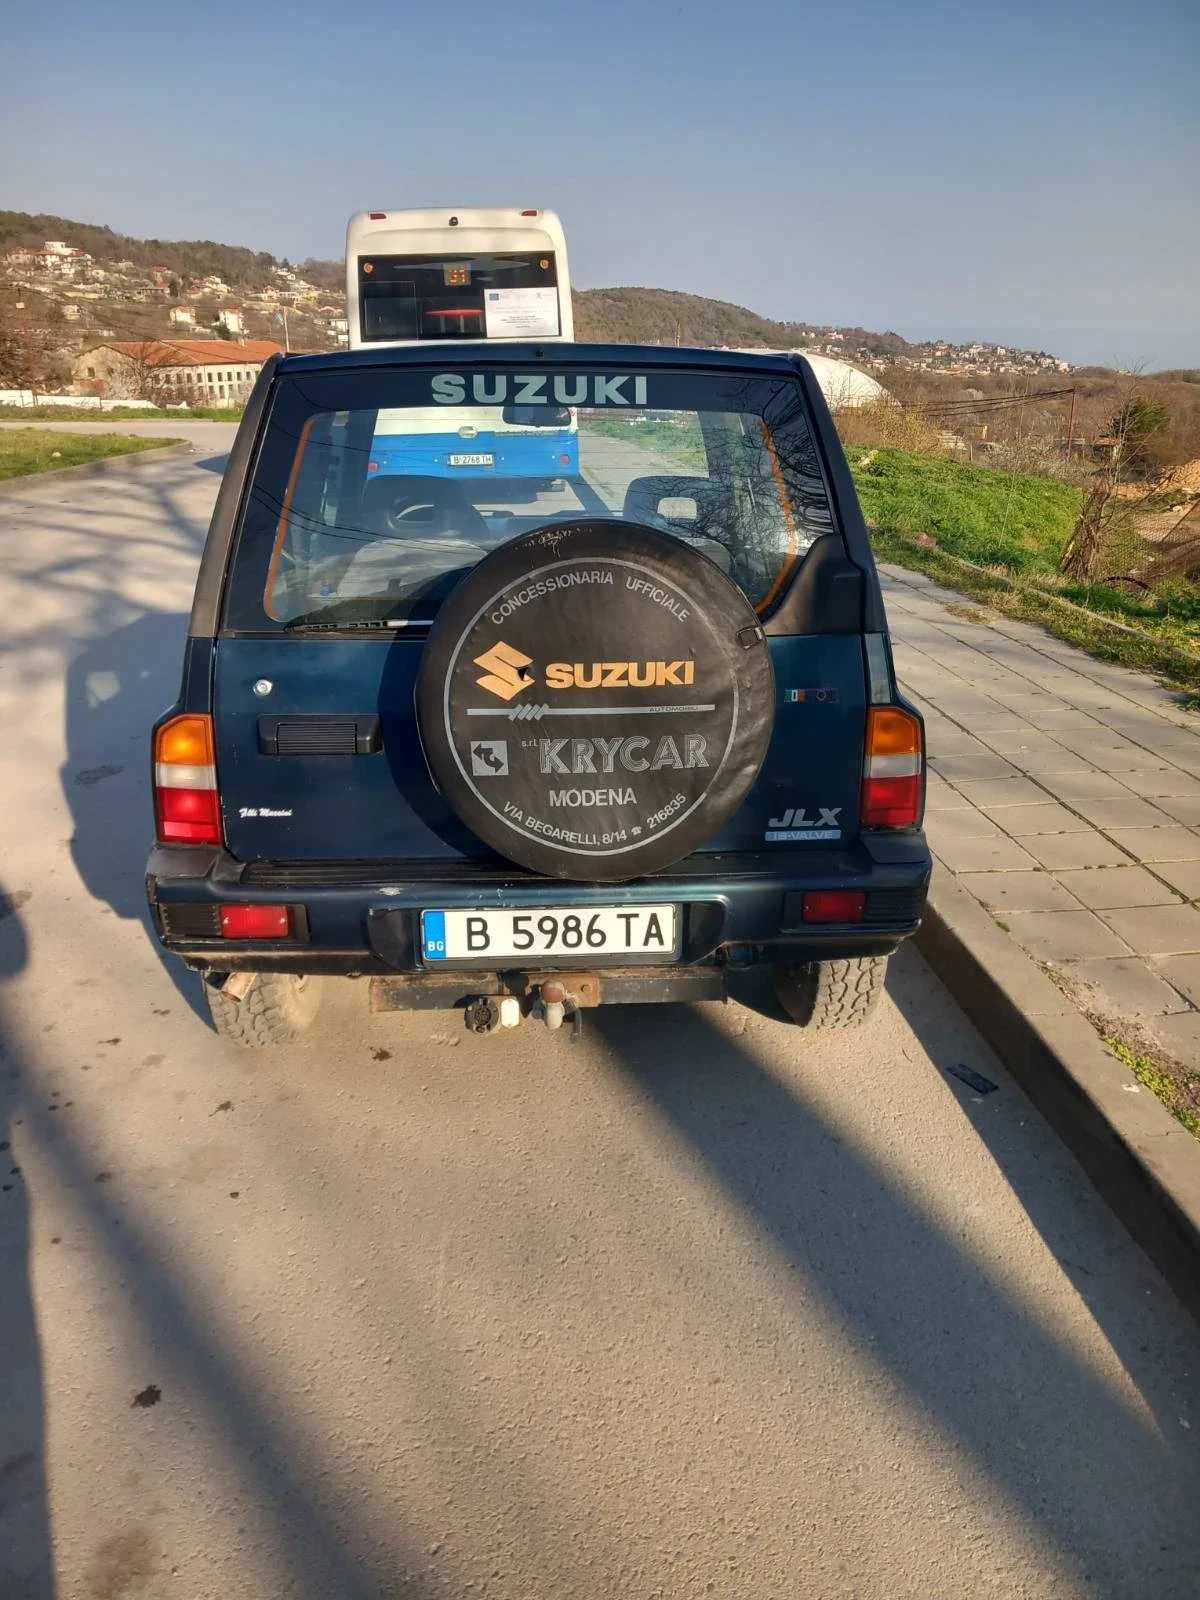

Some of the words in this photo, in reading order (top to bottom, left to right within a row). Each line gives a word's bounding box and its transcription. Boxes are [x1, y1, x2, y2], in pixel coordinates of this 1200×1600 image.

[431, 374, 648, 404] SUZUKI
[491, 571, 614, 625] CONCESSIONARIA
[625, 576, 691, 623] UFFICIALE
[545, 660, 695, 689] SUZUKI
[539, 734, 710, 774] KRYCAR
[549, 787, 637, 807] MODENA
[503, 801, 523, 822] VIA
[525, 816, 601, 847] BEGARELLI,
[602, 829, 628, 845] 8/14
[646, 792, 687, 829] 216835
[767, 807, 843, 827] JLX
[427, 940, 444, 951] BG
[466, 917, 491, 951] B
[512, 914, 607, 950] 5986
[616, 912, 665, 947] TA
